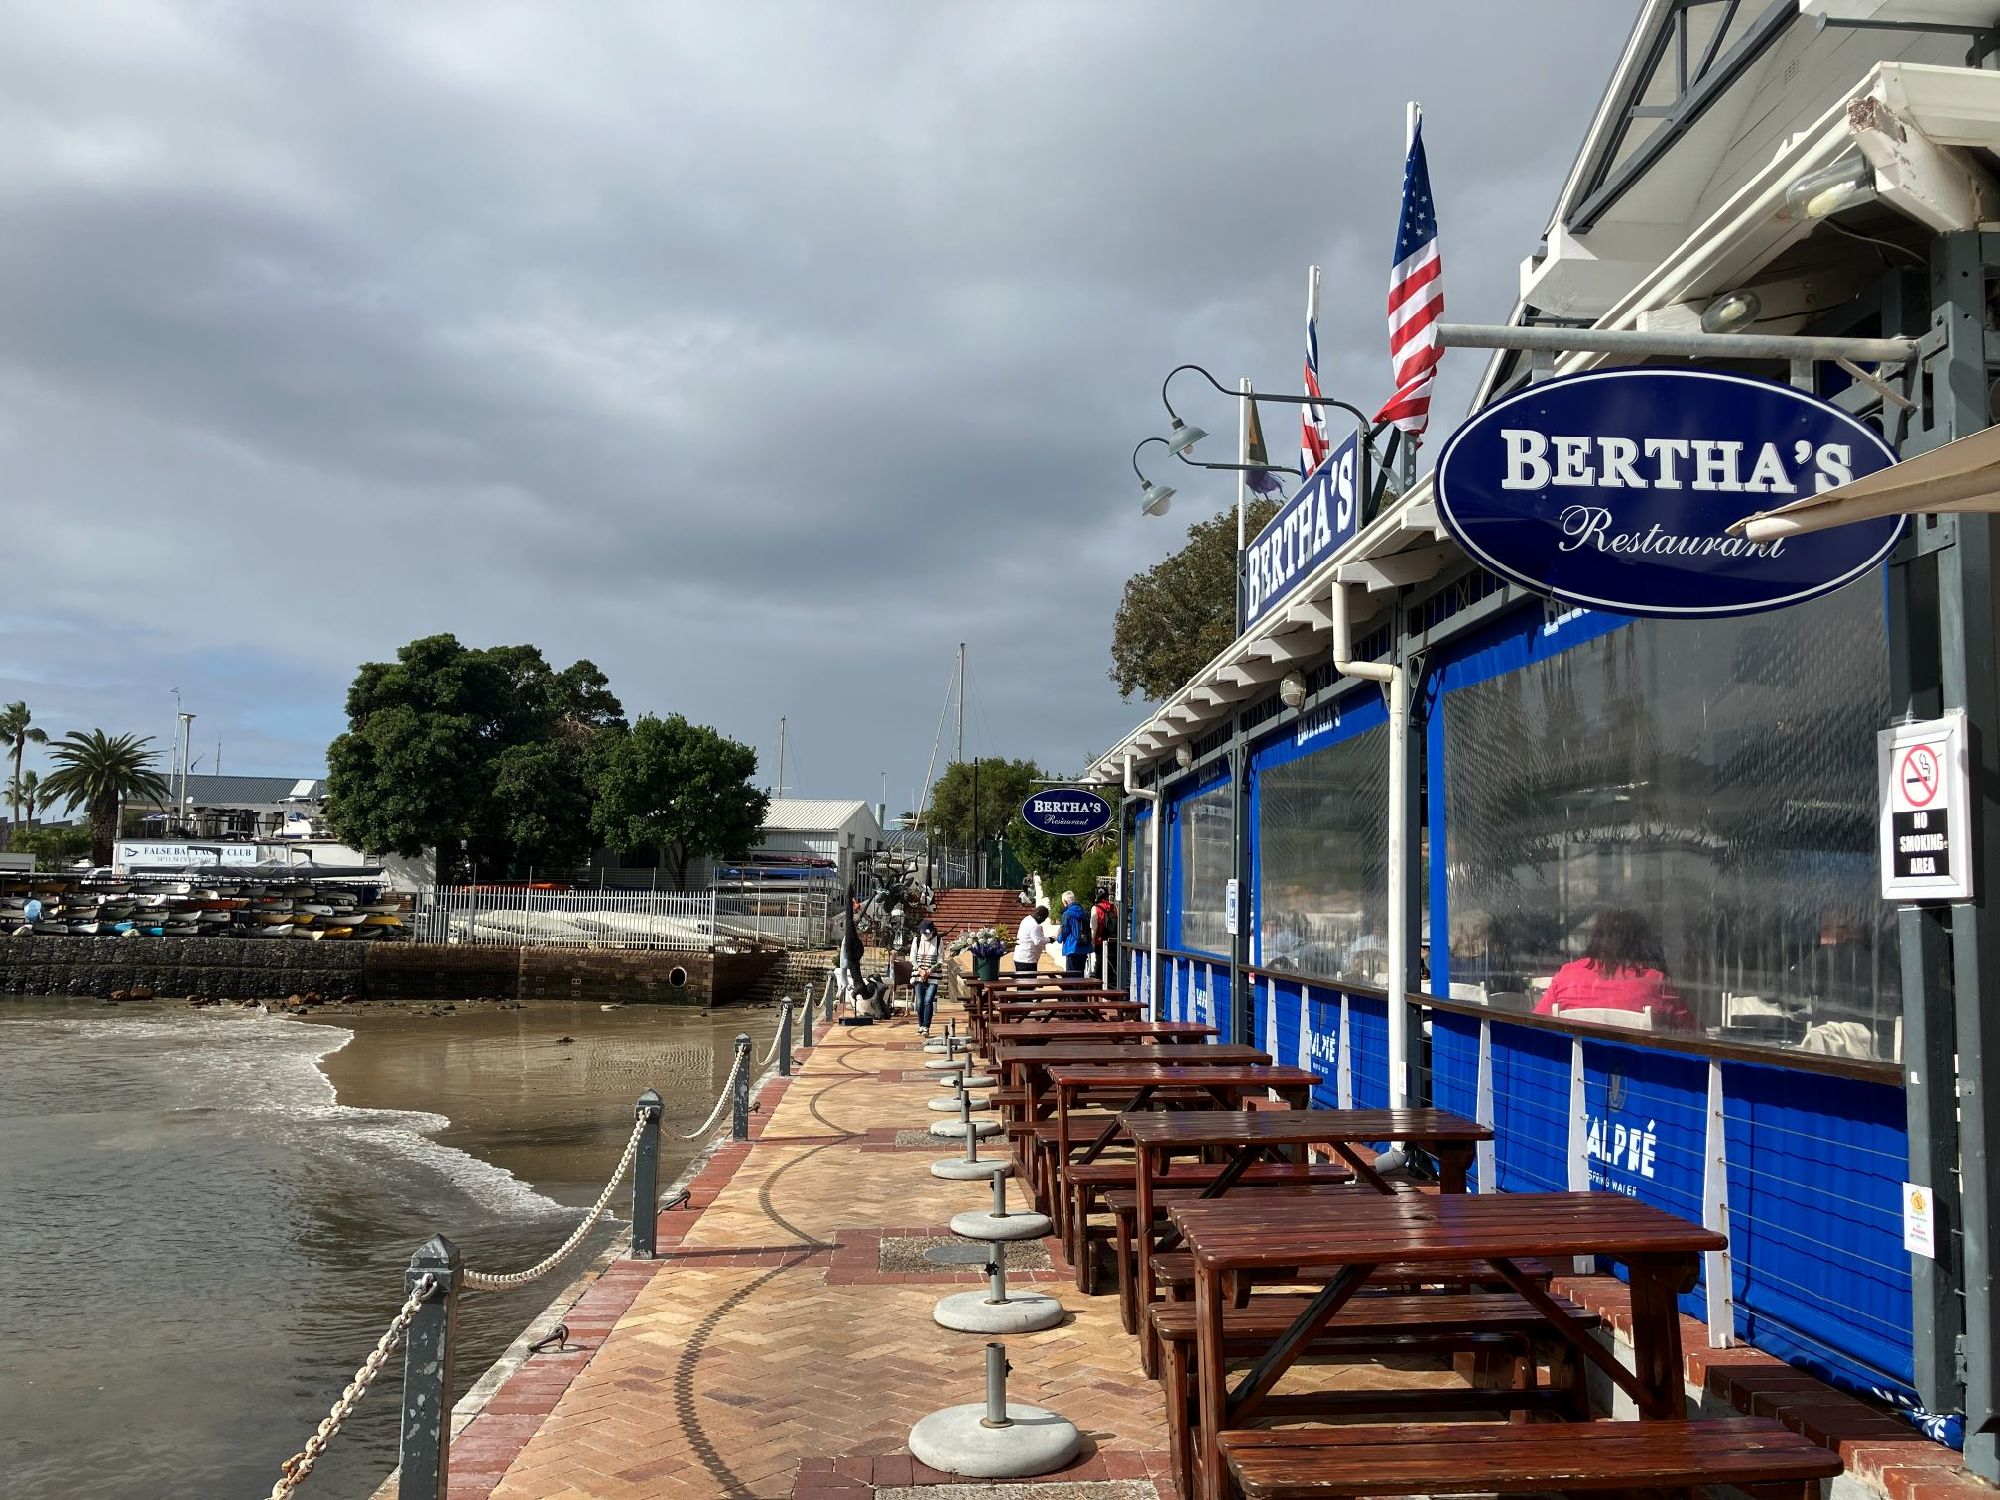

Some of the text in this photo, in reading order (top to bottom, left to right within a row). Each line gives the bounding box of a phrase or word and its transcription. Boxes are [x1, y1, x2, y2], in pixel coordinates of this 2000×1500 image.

[1501, 428, 1854, 495] BERTHA'S
[1248, 447, 1354, 621] BERTHA'S
[1033, 800, 1101, 813] BERTHA'S
[1044, 814, 1089, 826] Restaurant
[1913, 812, 1928, 829] NO
[1900, 833, 1944, 853] SMOKING
[144, 847, 172, 855] FALSE
[227, 849, 251, 857] CLUB
[1910, 857, 1936, 874] AREA
